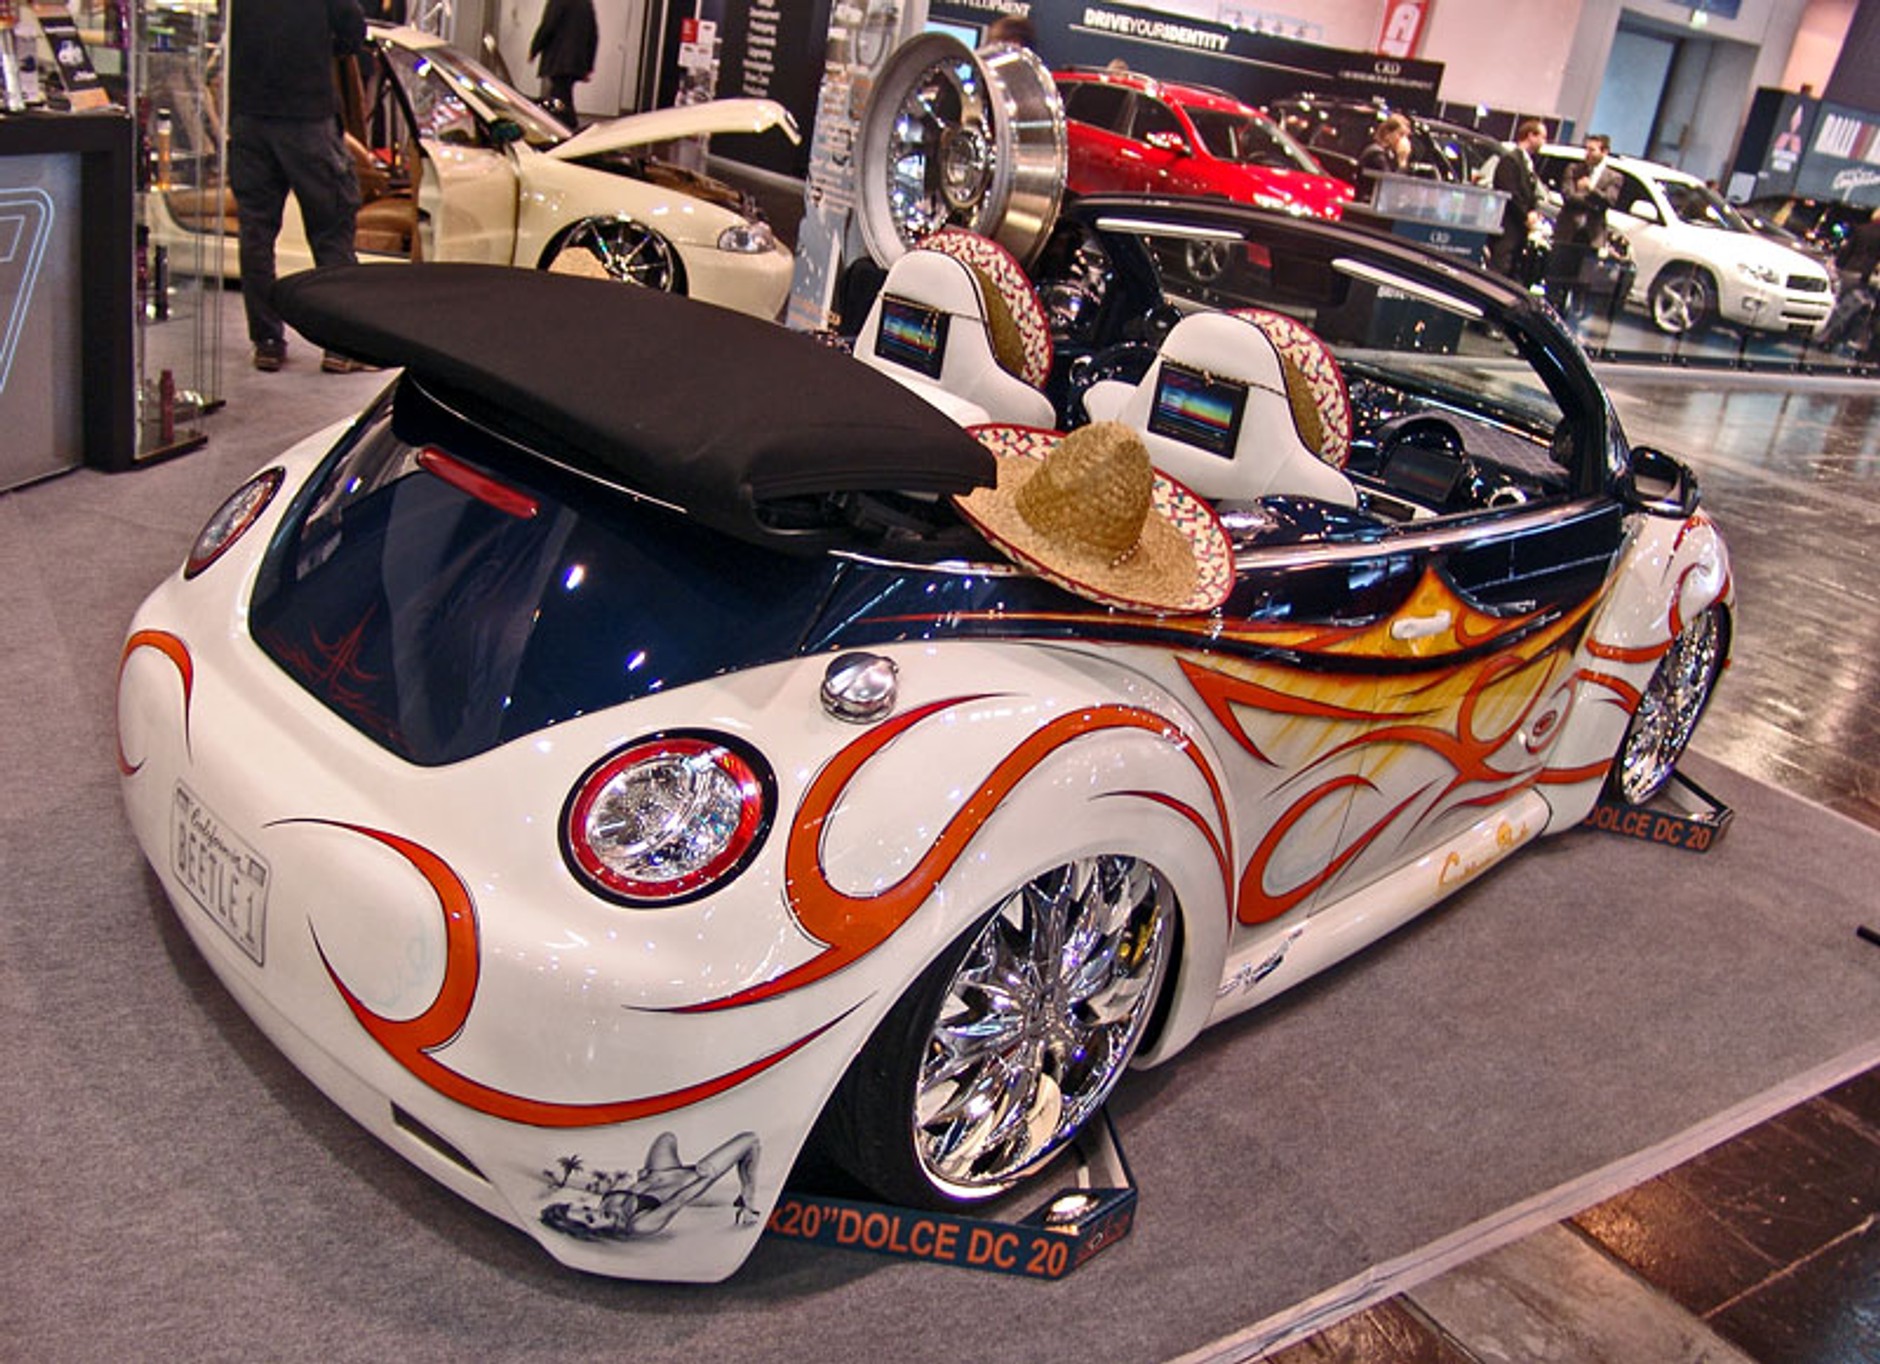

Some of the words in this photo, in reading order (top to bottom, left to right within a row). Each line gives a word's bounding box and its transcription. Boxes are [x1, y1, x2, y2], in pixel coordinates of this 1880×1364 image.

[1653, 818, 1685, 845] DC
[1685, 825, 1712, 850] 20
[177, 822, 239, 928] BEETLE
[966, 1228, 1021, 1269] DC
[1026, 1237, 1070, 1278] 20
